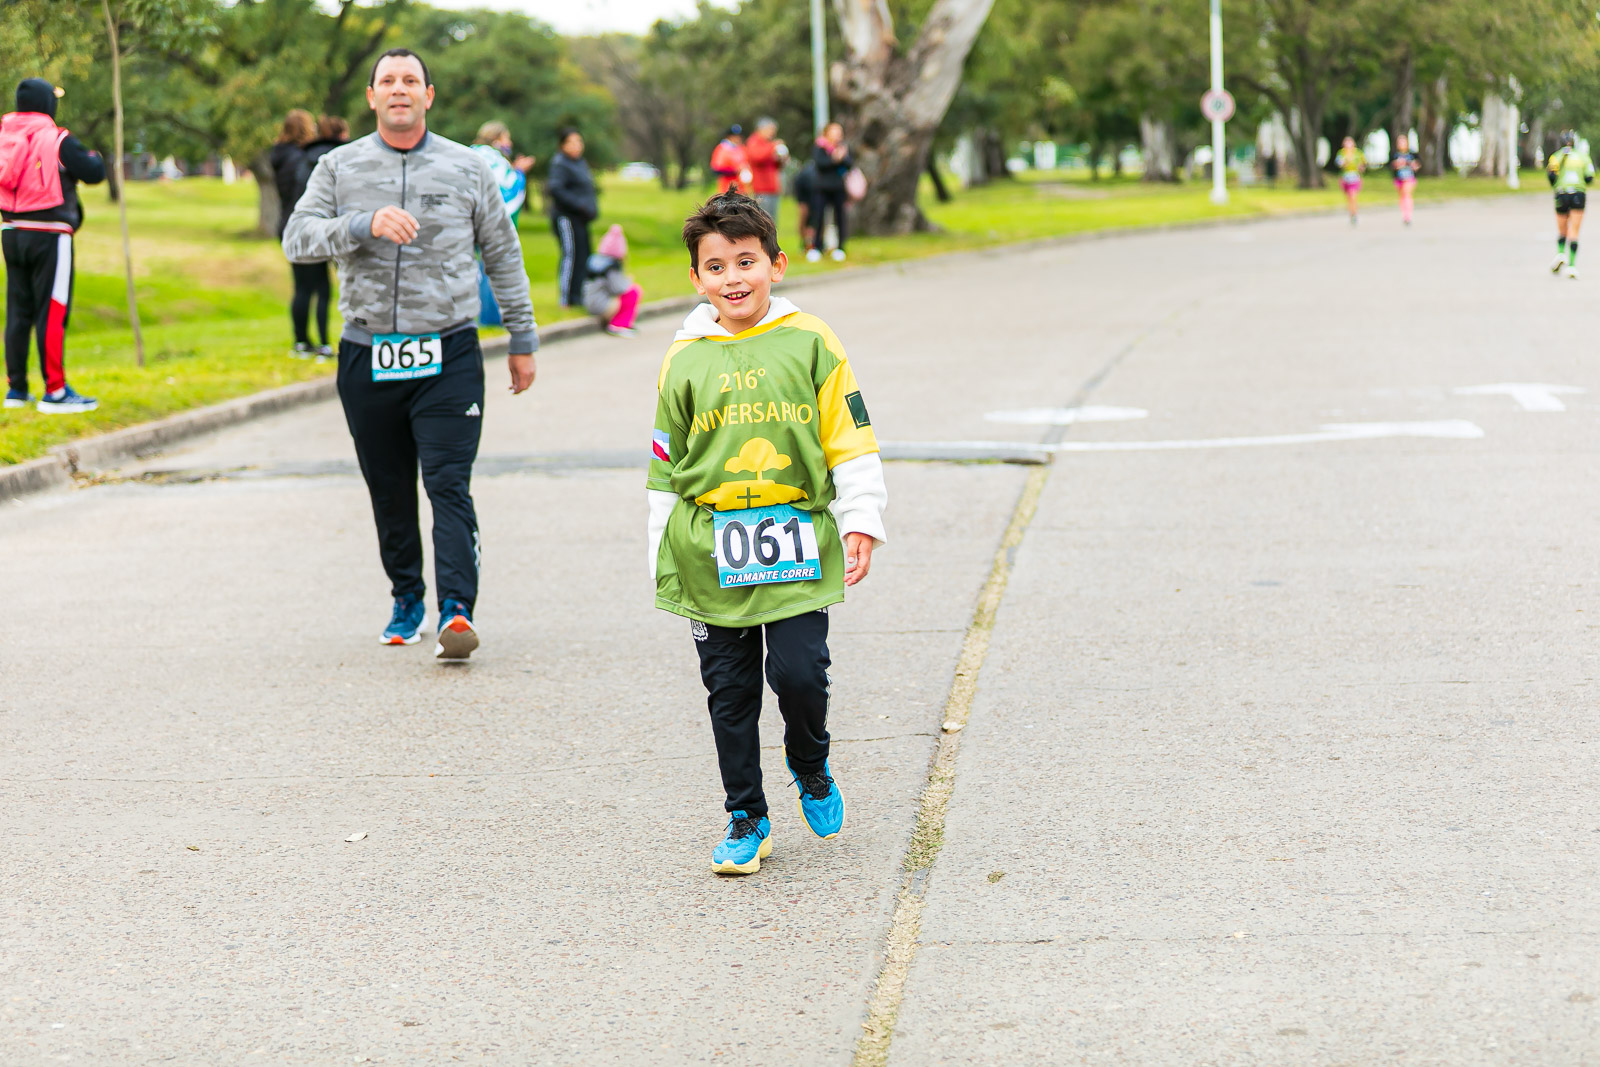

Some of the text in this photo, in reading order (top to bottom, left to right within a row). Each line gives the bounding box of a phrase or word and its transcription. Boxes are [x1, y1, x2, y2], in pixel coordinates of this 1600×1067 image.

[378, 336, 433, 369] 065
[722, 516, 804, 570] 061
[725, 567, 816, 585] DIAMANTE CORRE
